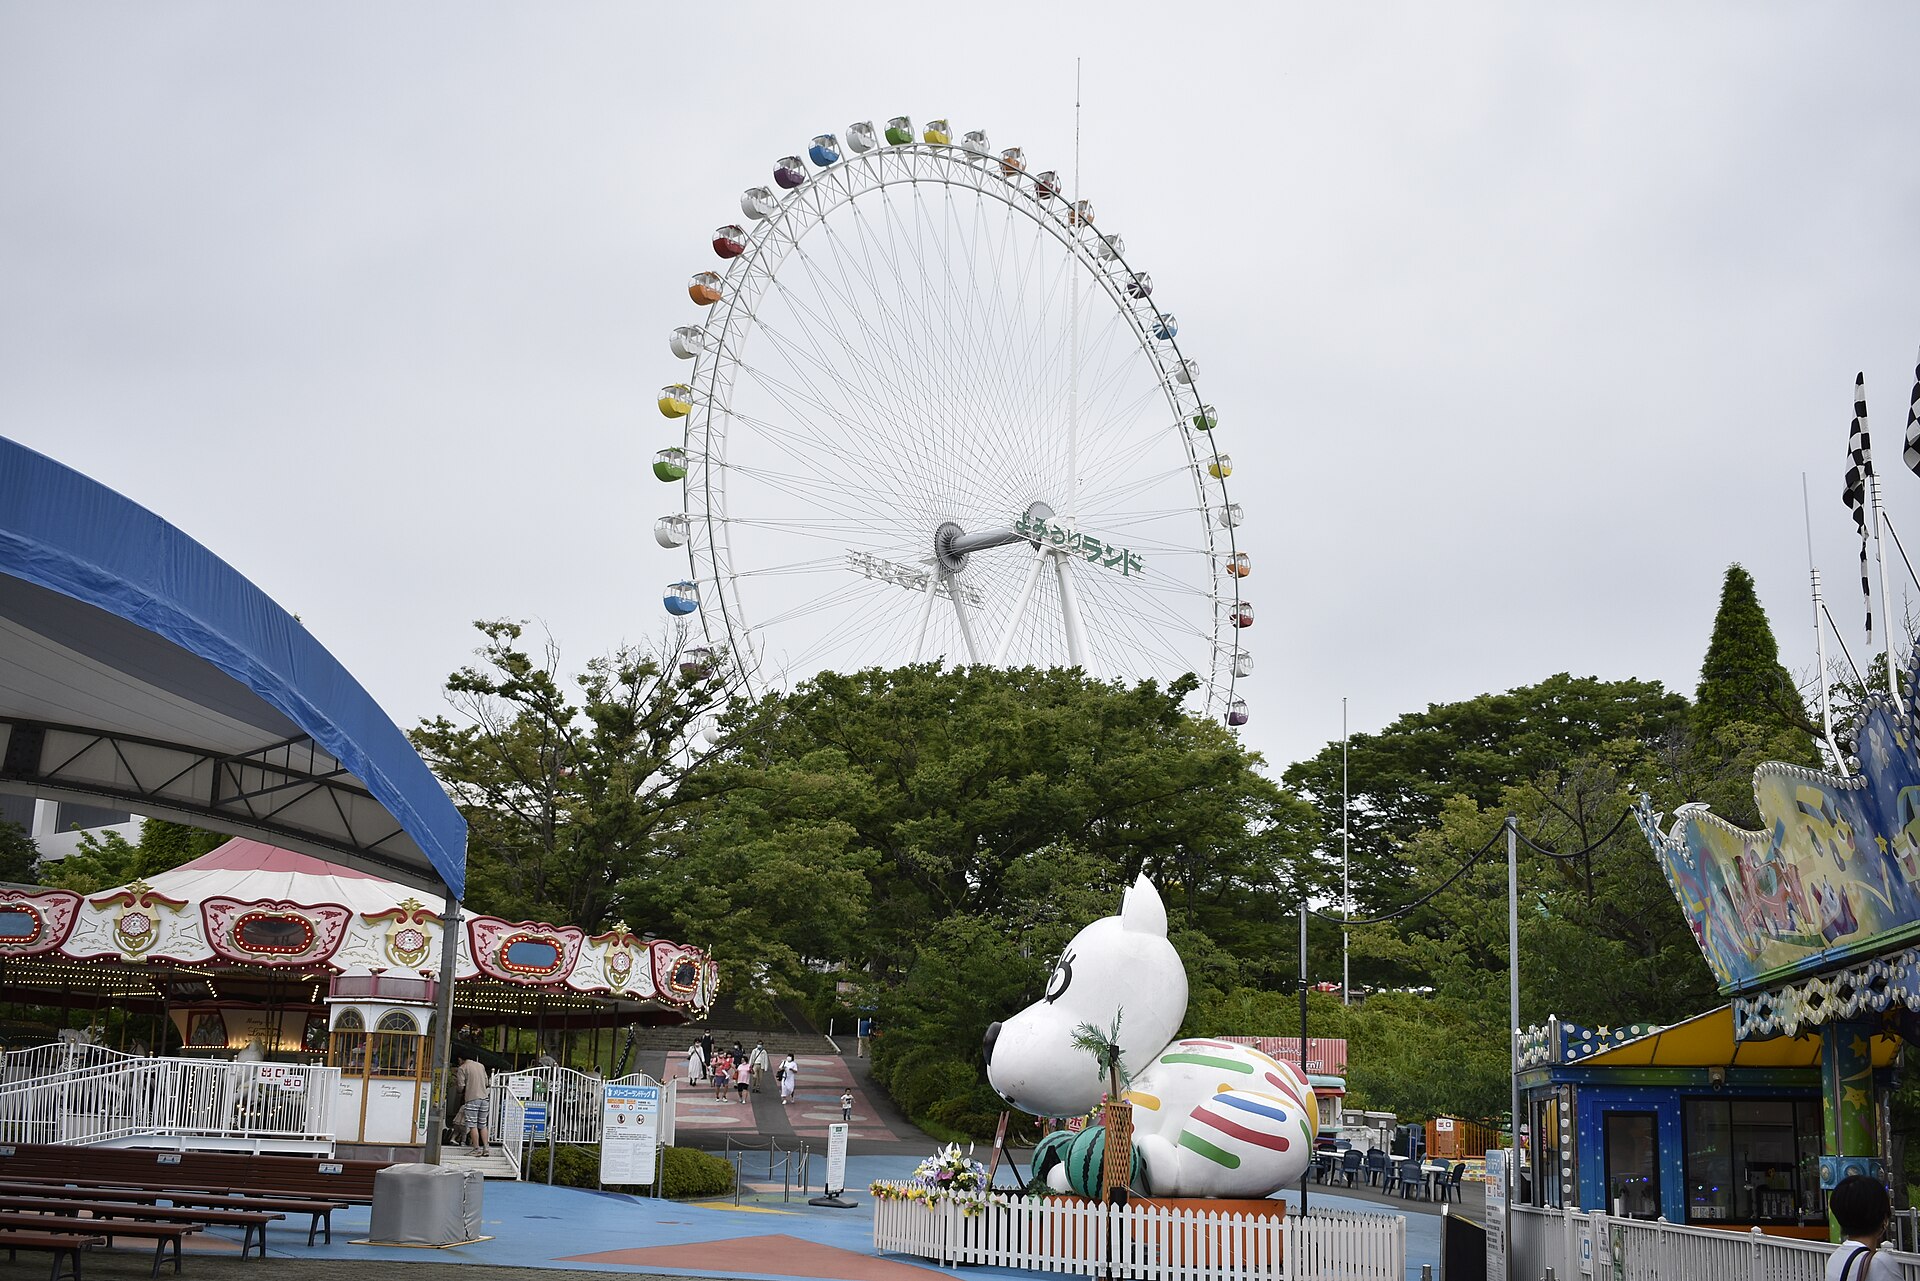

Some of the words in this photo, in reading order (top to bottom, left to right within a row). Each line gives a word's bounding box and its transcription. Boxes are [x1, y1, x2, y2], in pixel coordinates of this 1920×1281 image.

[1015, 511, 1143, 577] よみうりランド
[284, 1079, 301, 1087] 出口
